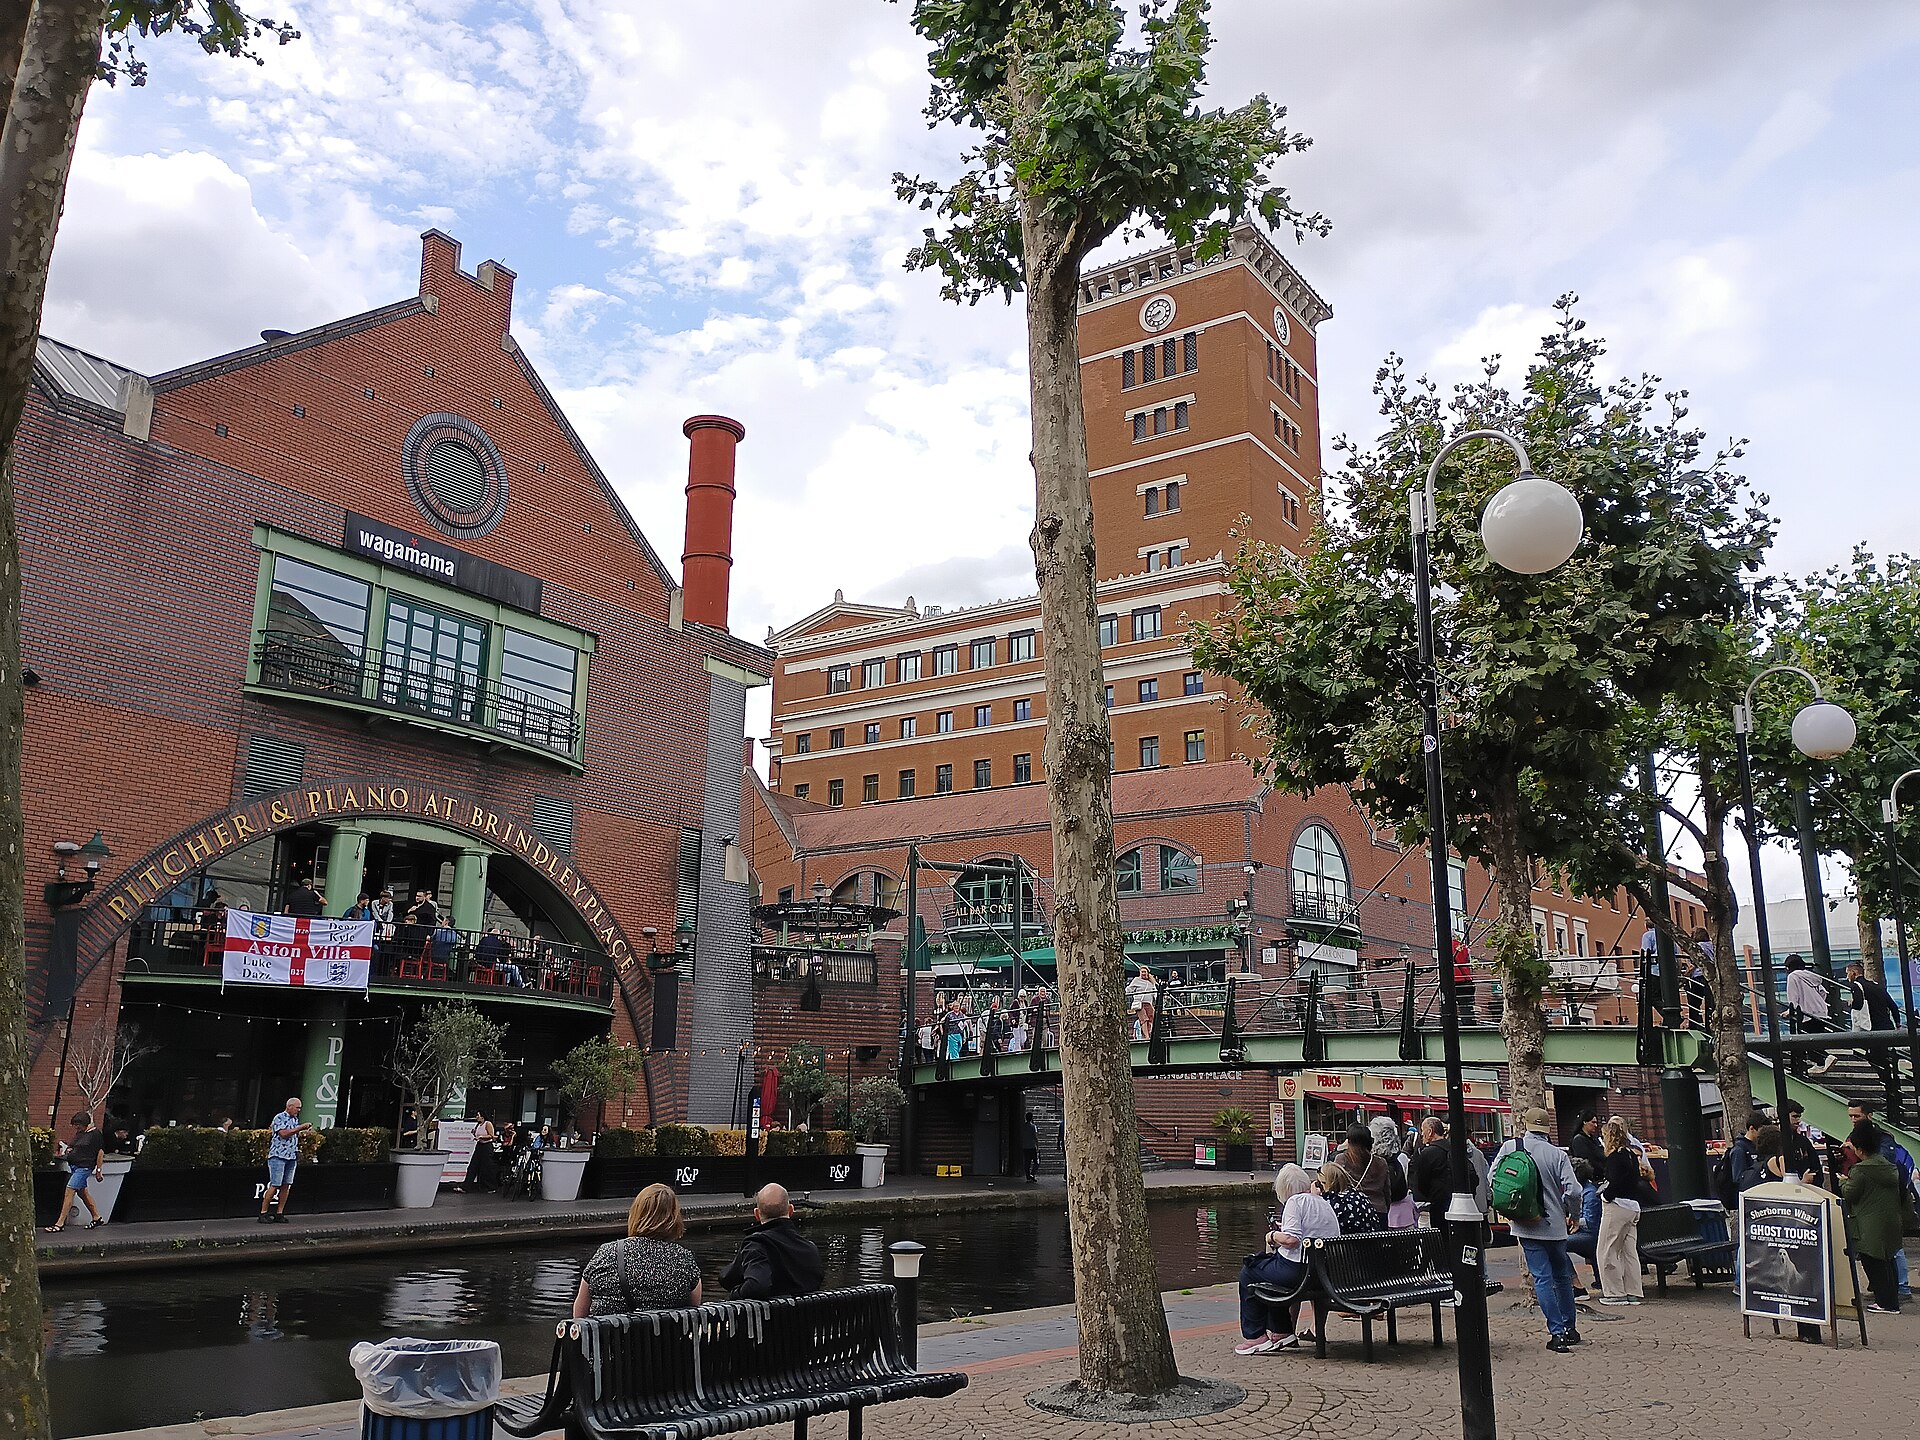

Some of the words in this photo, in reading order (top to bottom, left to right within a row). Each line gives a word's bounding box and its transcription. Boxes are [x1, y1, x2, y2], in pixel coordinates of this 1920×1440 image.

[358, 530, 455, 576] wagamama
[107, 814, 257, 921] PITCHER
[271, 800, 294, 824] &
[307, 786, 409, 813] PIANO
[424, 793, 457, 818] AT
[471, 805, 635, 973] BRINDLEYPLACE
[329, 932, 355, 945] Kyle
[247, 941, 301, 958] Aston
[309, 945, 351, 960] Villa
[243, 955, 272, 969] Luke
[242, 968, 272, 980] Dazz
[675, 1166, 699, 1183] P&P
[829, 1164, 850, 1180] P&P
[1750, 1206, 1792, 1220] Sherborne
[1794, 1208, 1819, 1225] Wharf
[1750, 1224, 1782, 1237] GHOST
[1783, 1227, 1818, 1241] TOURS
